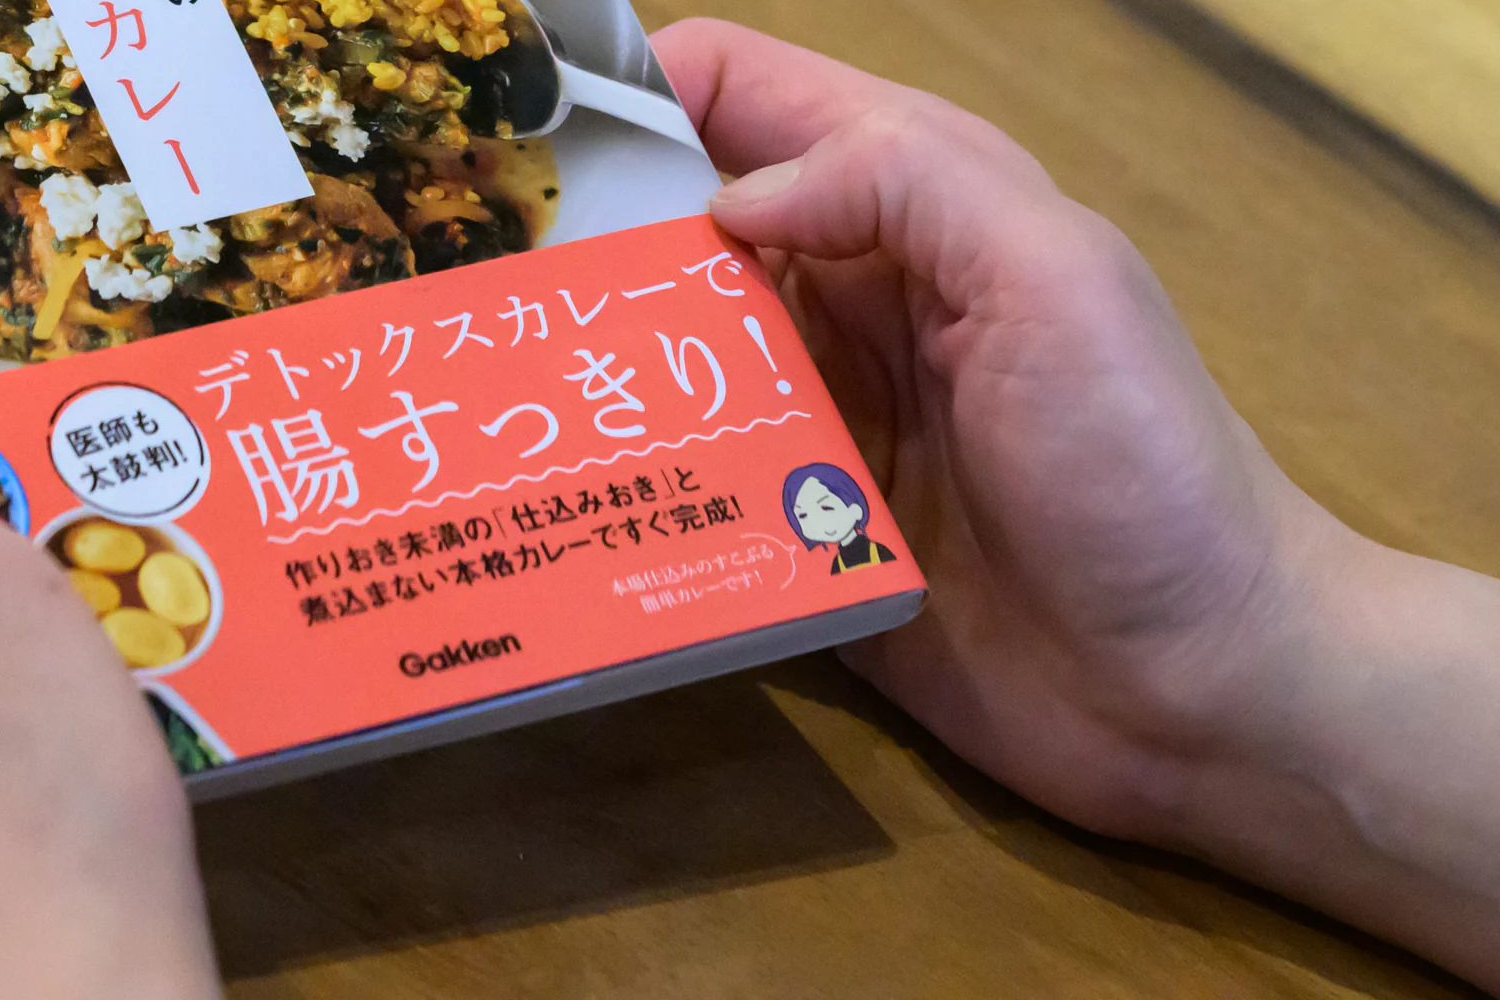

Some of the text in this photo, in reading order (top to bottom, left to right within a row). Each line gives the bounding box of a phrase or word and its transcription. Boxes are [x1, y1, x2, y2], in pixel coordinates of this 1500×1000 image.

[195, 251, 746, 421] デトックスカレーで
[65, 410, 159, 458] 医師も
[400, 633, 521, 678] Gakken
